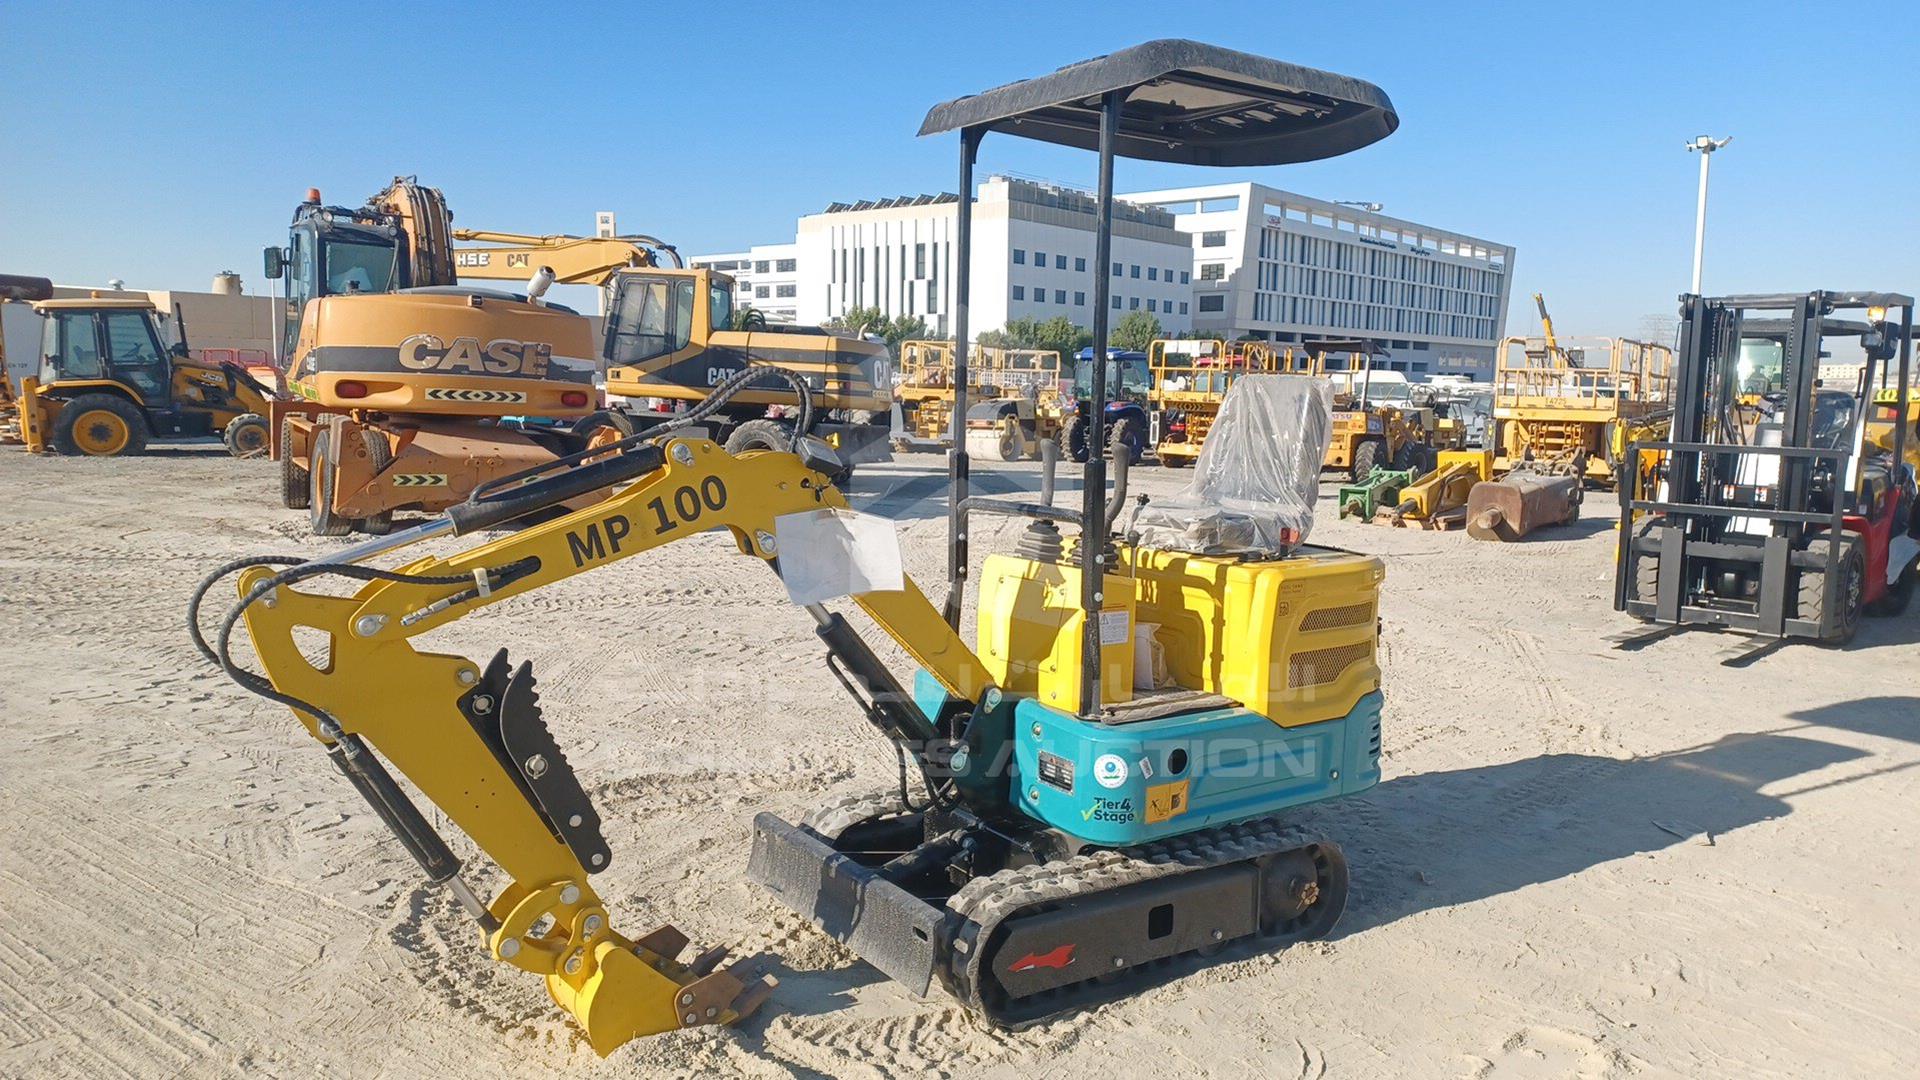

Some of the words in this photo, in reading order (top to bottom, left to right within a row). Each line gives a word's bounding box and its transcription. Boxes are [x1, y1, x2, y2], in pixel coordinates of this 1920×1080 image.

[507, 253, 530, 267] CAT
[399, 334, 552, 375] CASE
[707, 367, 736, 386] CAT
[566, 515, 630, 568] MP
[647, 475, 727, 535] 100
[1094, 810, 1134, 824] Stage
